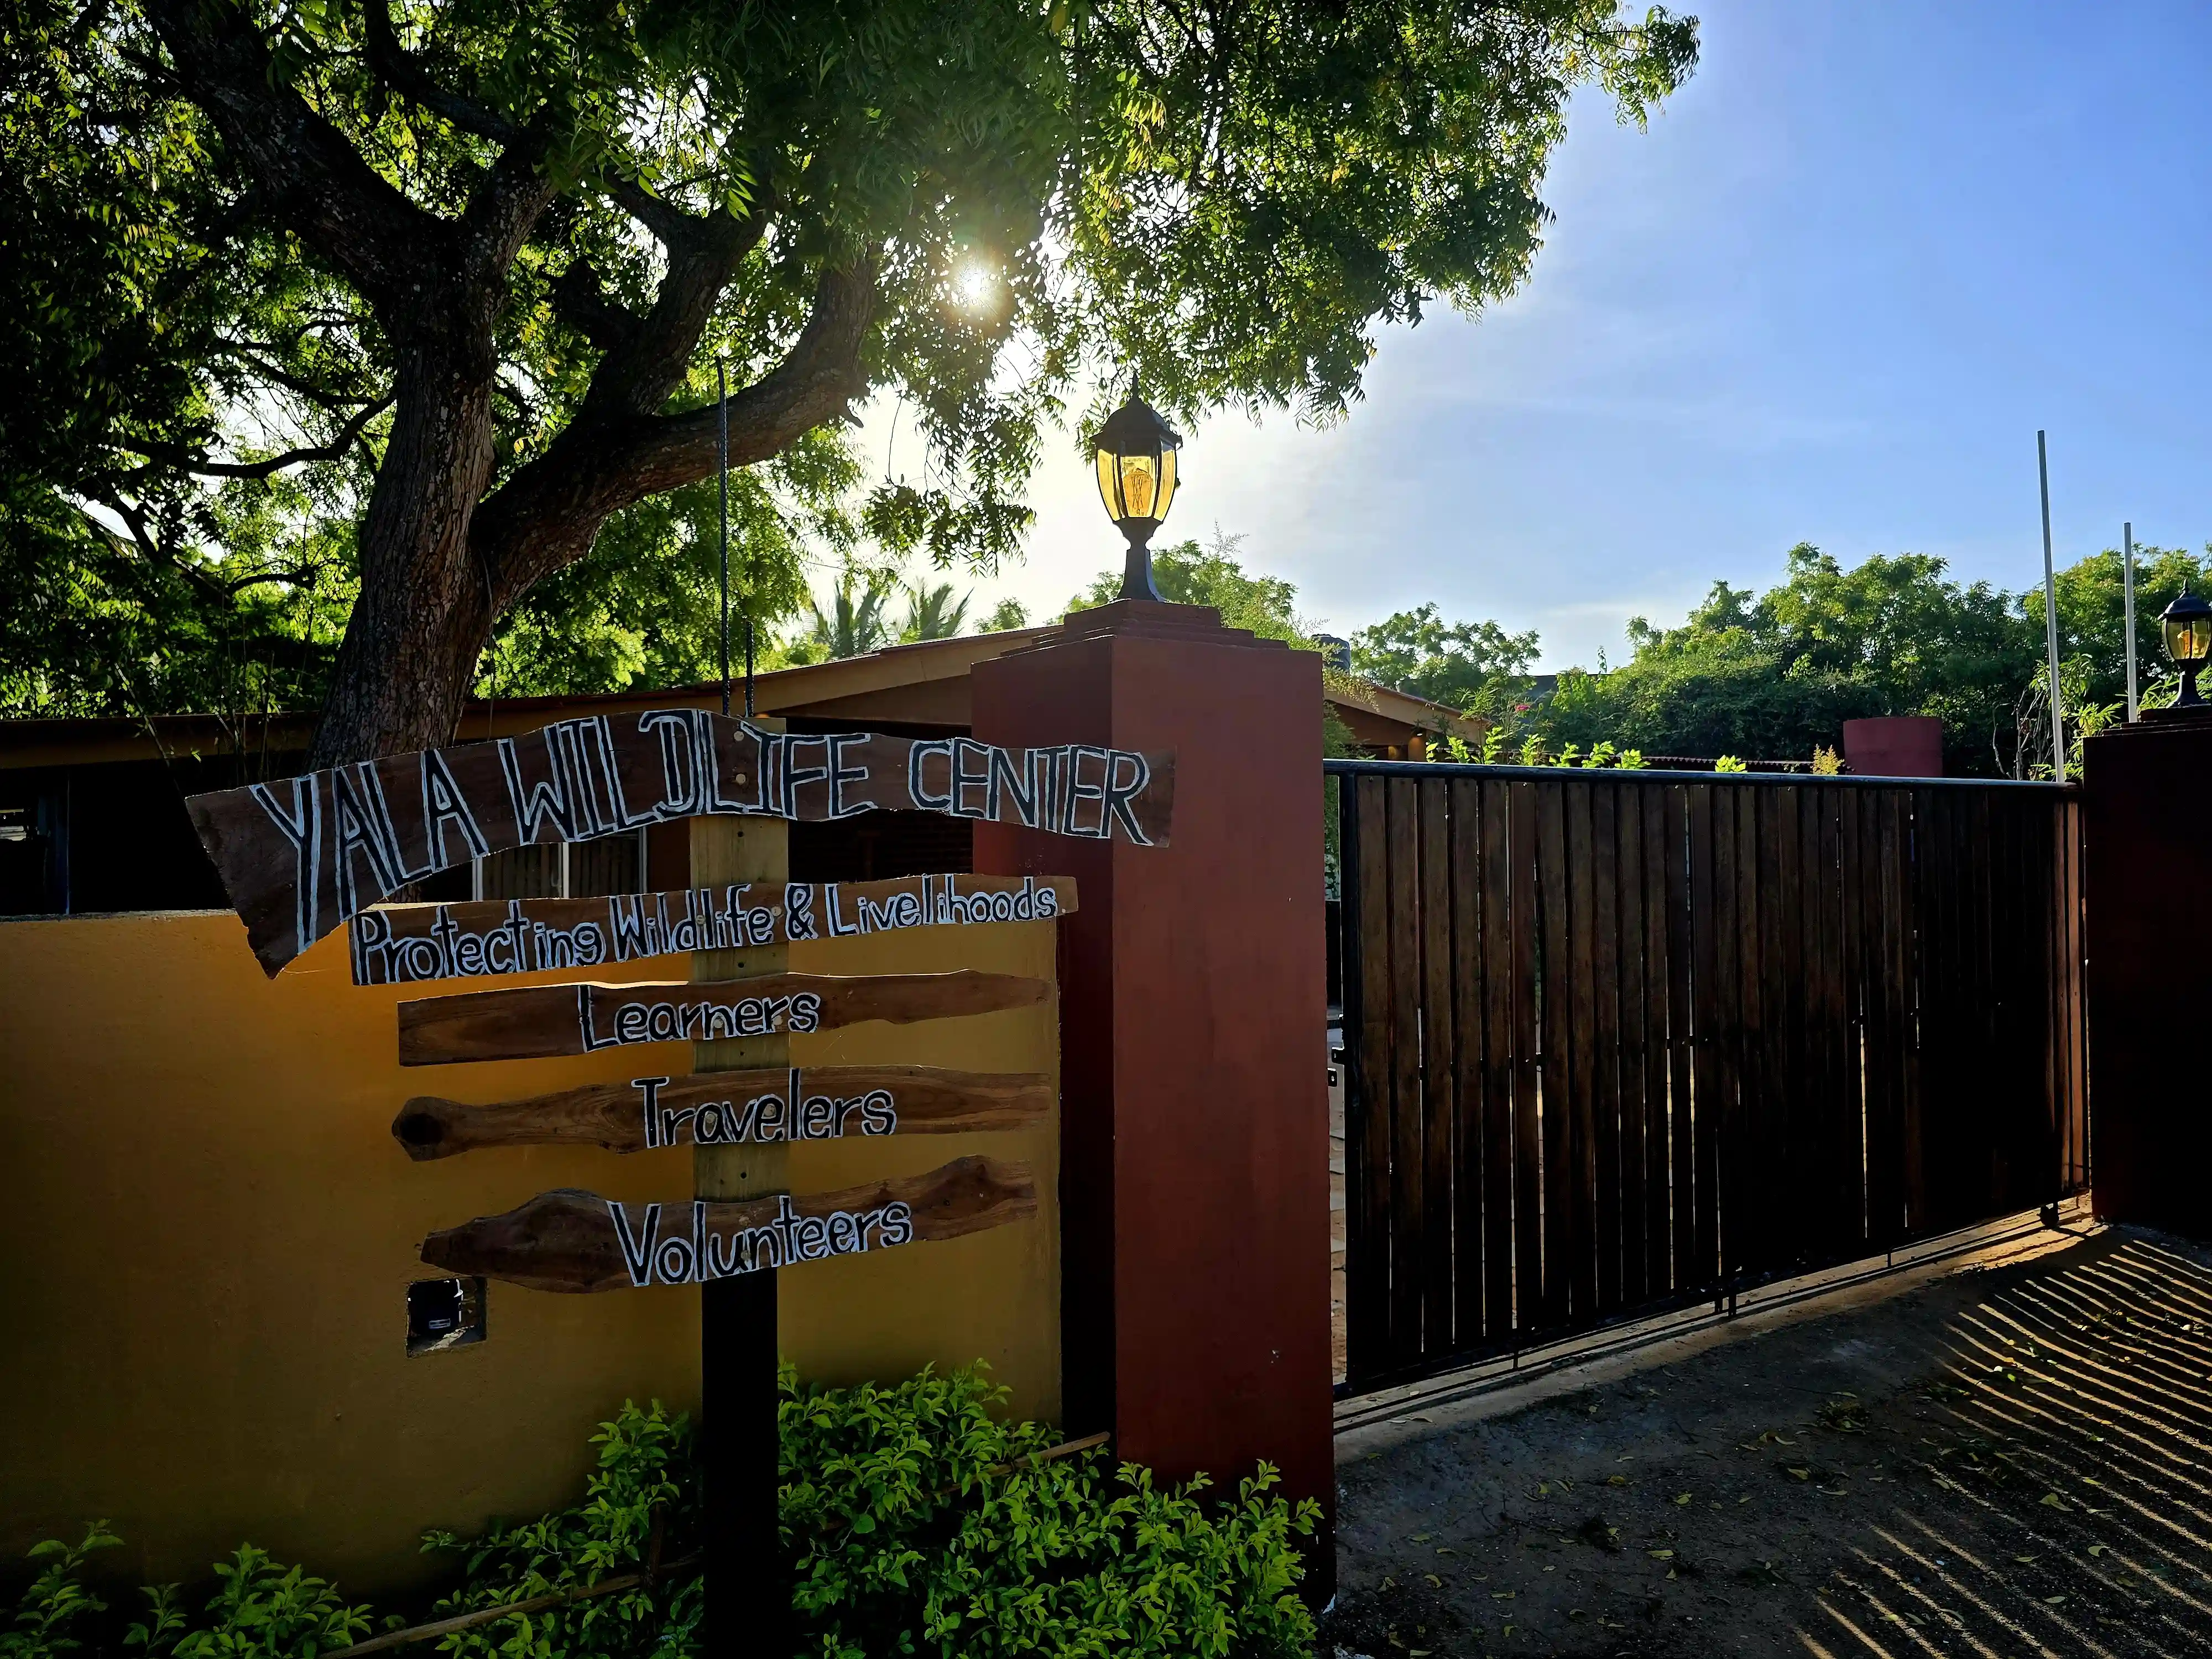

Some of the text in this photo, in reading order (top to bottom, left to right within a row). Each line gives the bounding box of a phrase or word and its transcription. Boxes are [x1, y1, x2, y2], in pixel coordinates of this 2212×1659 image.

[249, 708, 1154, 954] YALA WILDLIFE CENTER
[353, 874, 1058, 985] Protecting Wildlife & Livelihoods
[577, 985, 821, 1052] Learners
[631, 1067, 896, 1149] Travelers
[607, 1195, 912, 1287] Volunteers
